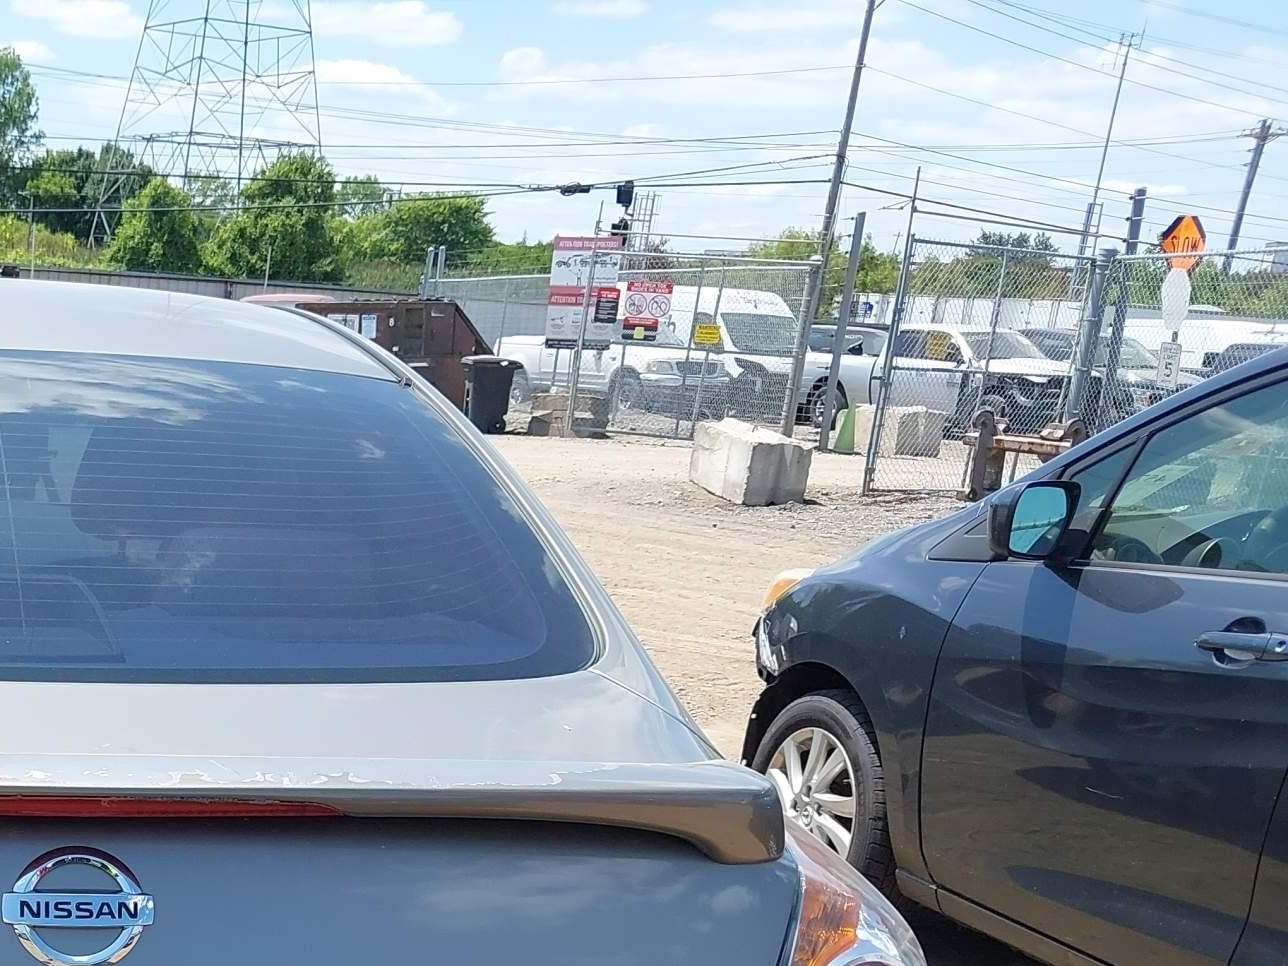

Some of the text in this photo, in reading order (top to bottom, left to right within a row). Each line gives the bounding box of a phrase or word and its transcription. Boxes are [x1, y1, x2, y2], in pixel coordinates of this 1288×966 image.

[1170, 235, 1201, 256] SLOW
[550, 295, 576, 304] ATTENTION
[1163, 361, 1173, 378] 5
[19, 900, 139, 920] NISSAN
